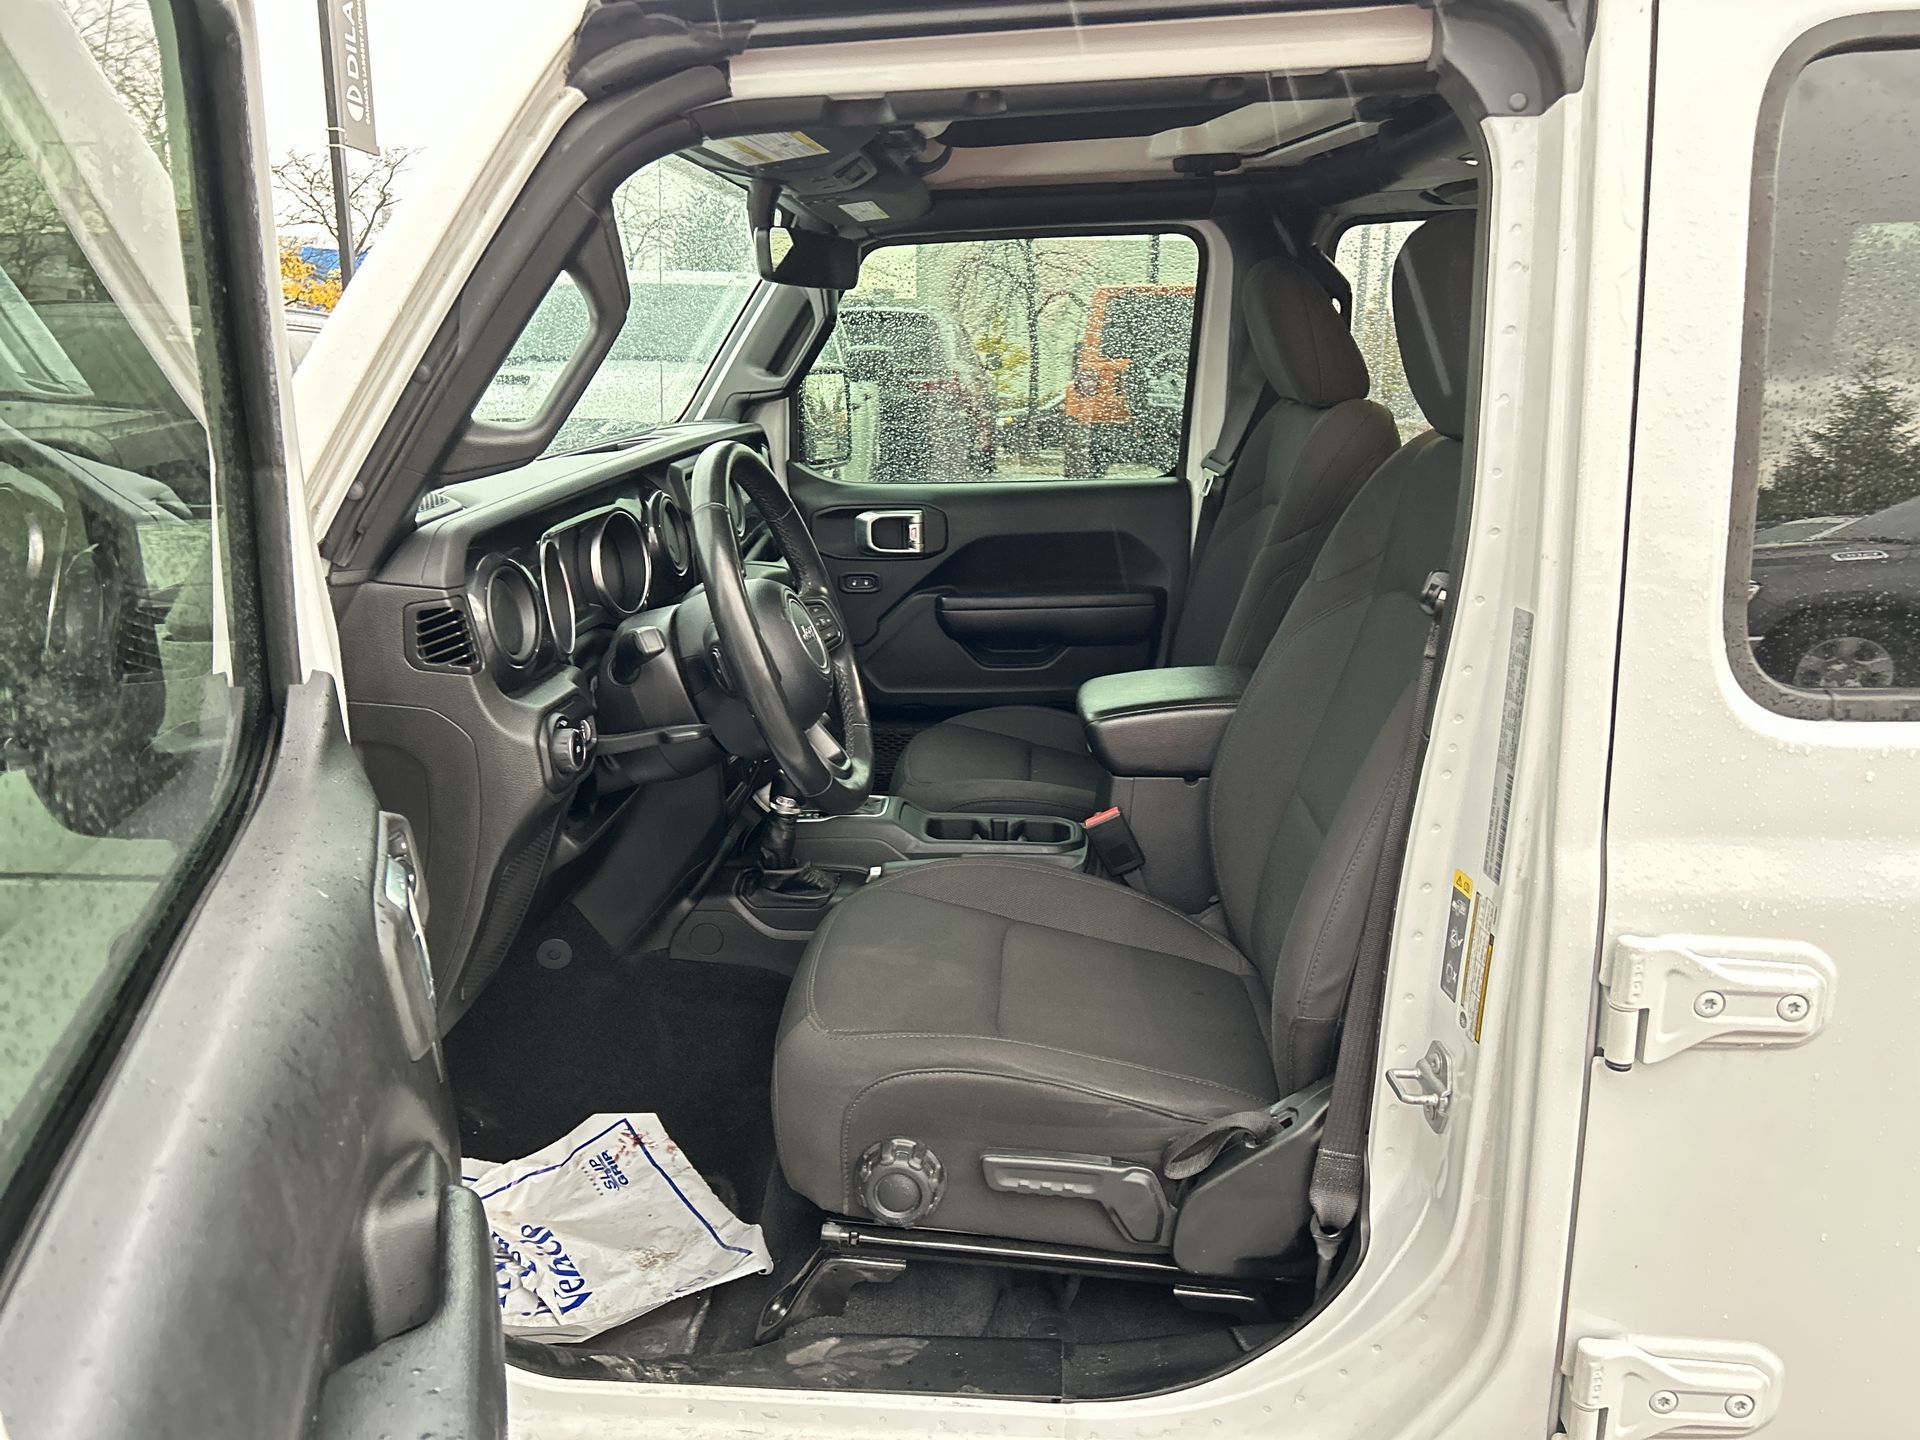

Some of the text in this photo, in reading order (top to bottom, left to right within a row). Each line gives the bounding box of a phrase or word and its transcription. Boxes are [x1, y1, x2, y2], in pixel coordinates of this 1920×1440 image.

[589, 1159, 616, 1189] SLIP
[601, 1150, 629, 1185] GRIP
[519, 1224, 593, 1315] Vehcle
